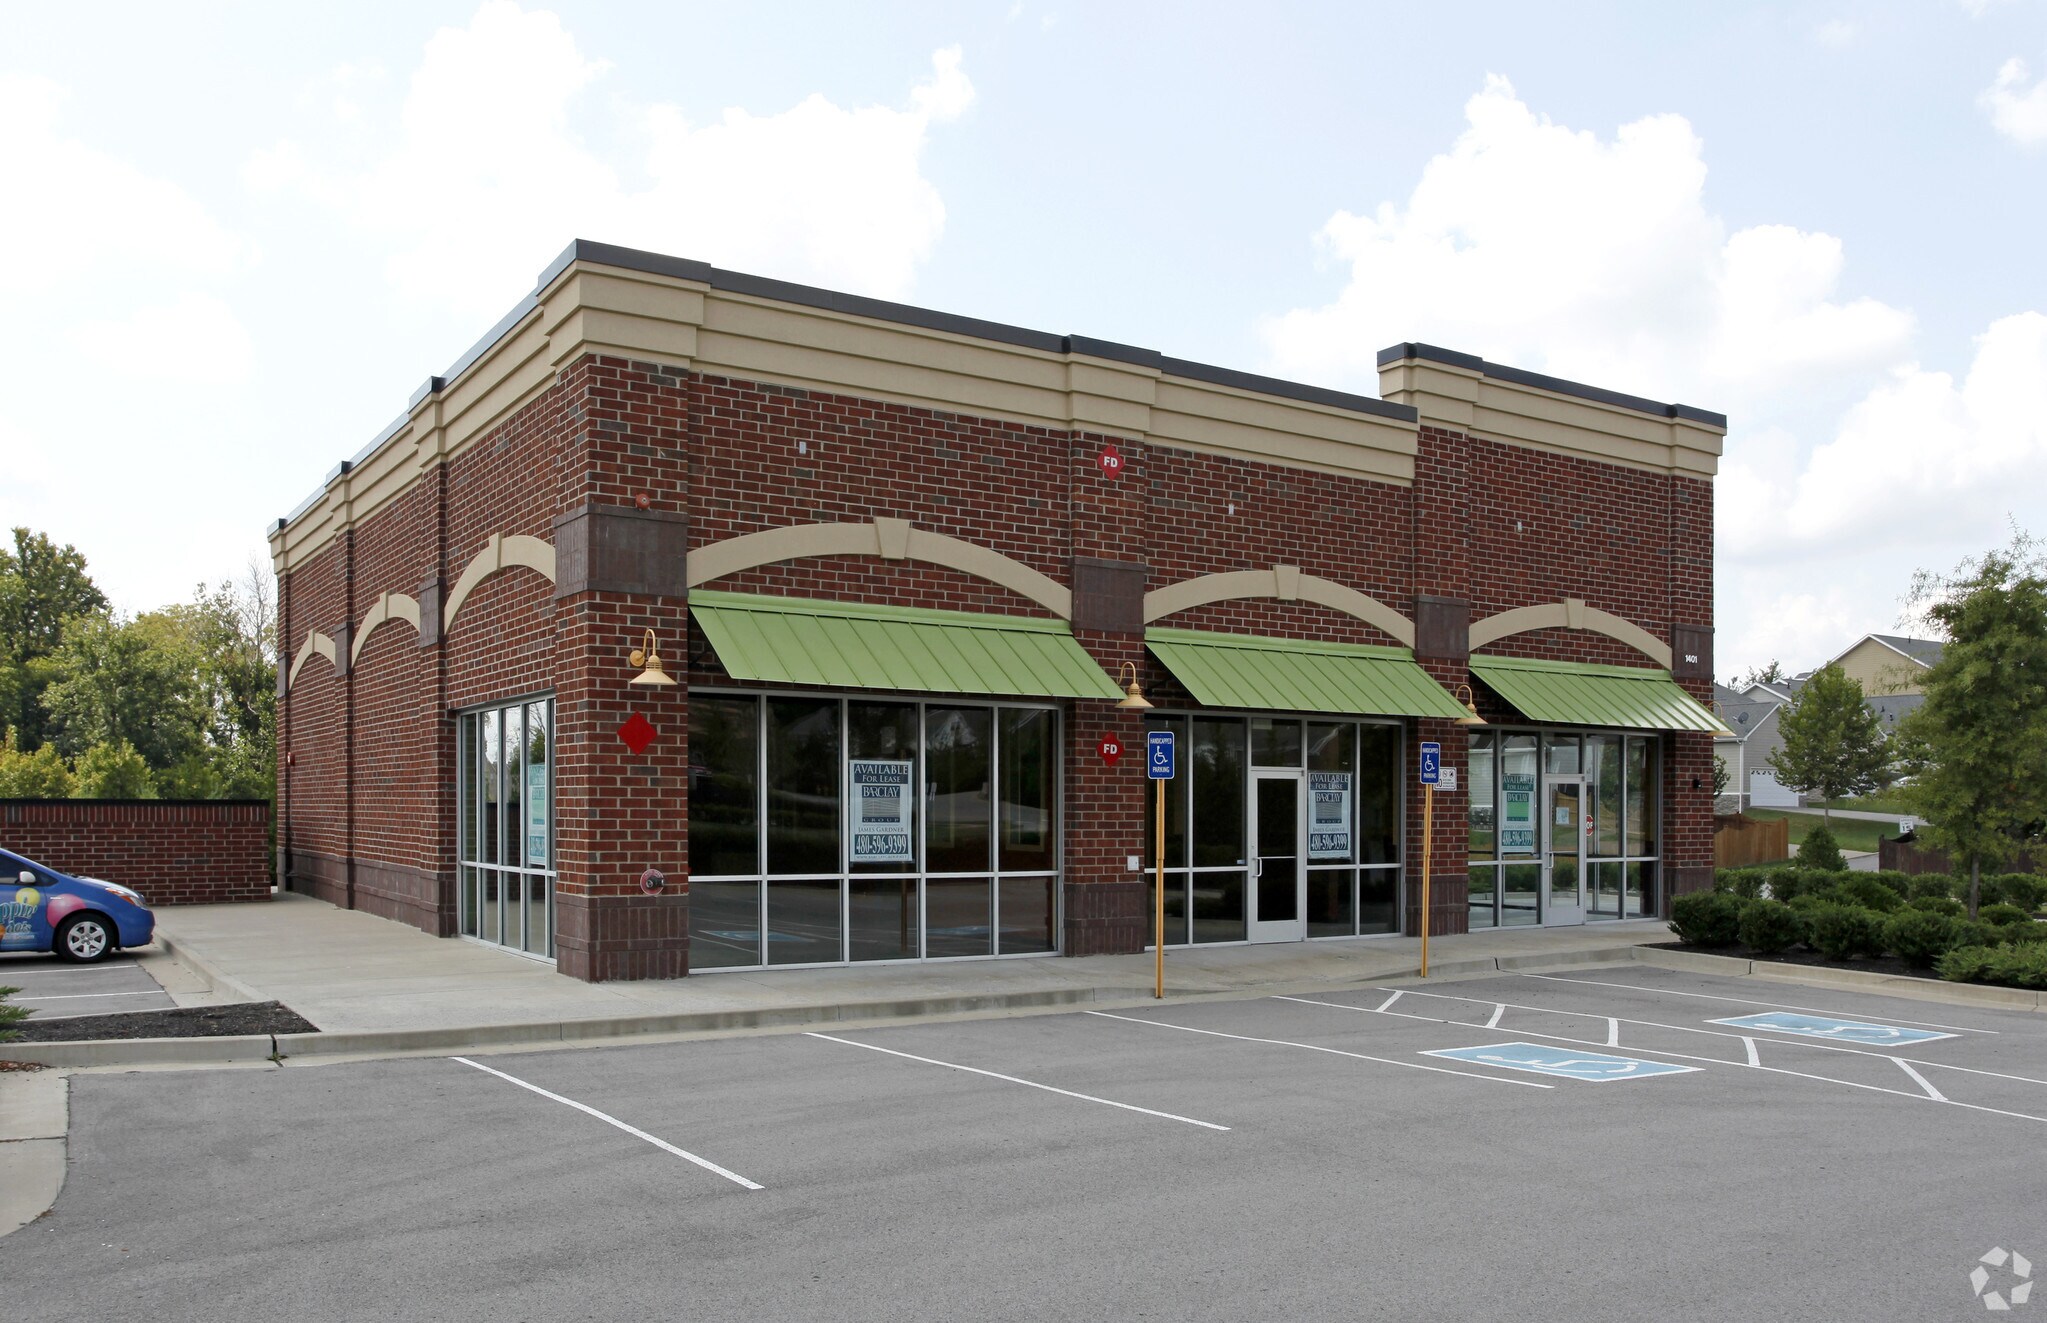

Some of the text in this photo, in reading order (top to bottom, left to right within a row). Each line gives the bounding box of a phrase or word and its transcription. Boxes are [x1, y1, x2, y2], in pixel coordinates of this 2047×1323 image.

[1103, 456, 1119, 468] FD
[1685, 654, 1698, 664] 1401
[1103, 743, 1118, 755] FD
[854, 764, 908, 775] AVAILABLE
[862, 774, 901, 783] FOR LEASE
[1311, 774, 1348, 783] AVAILABLE
[863, 786, 900, 798] BARCLAY
[855, 835, 907, 854] 480-596-9399
